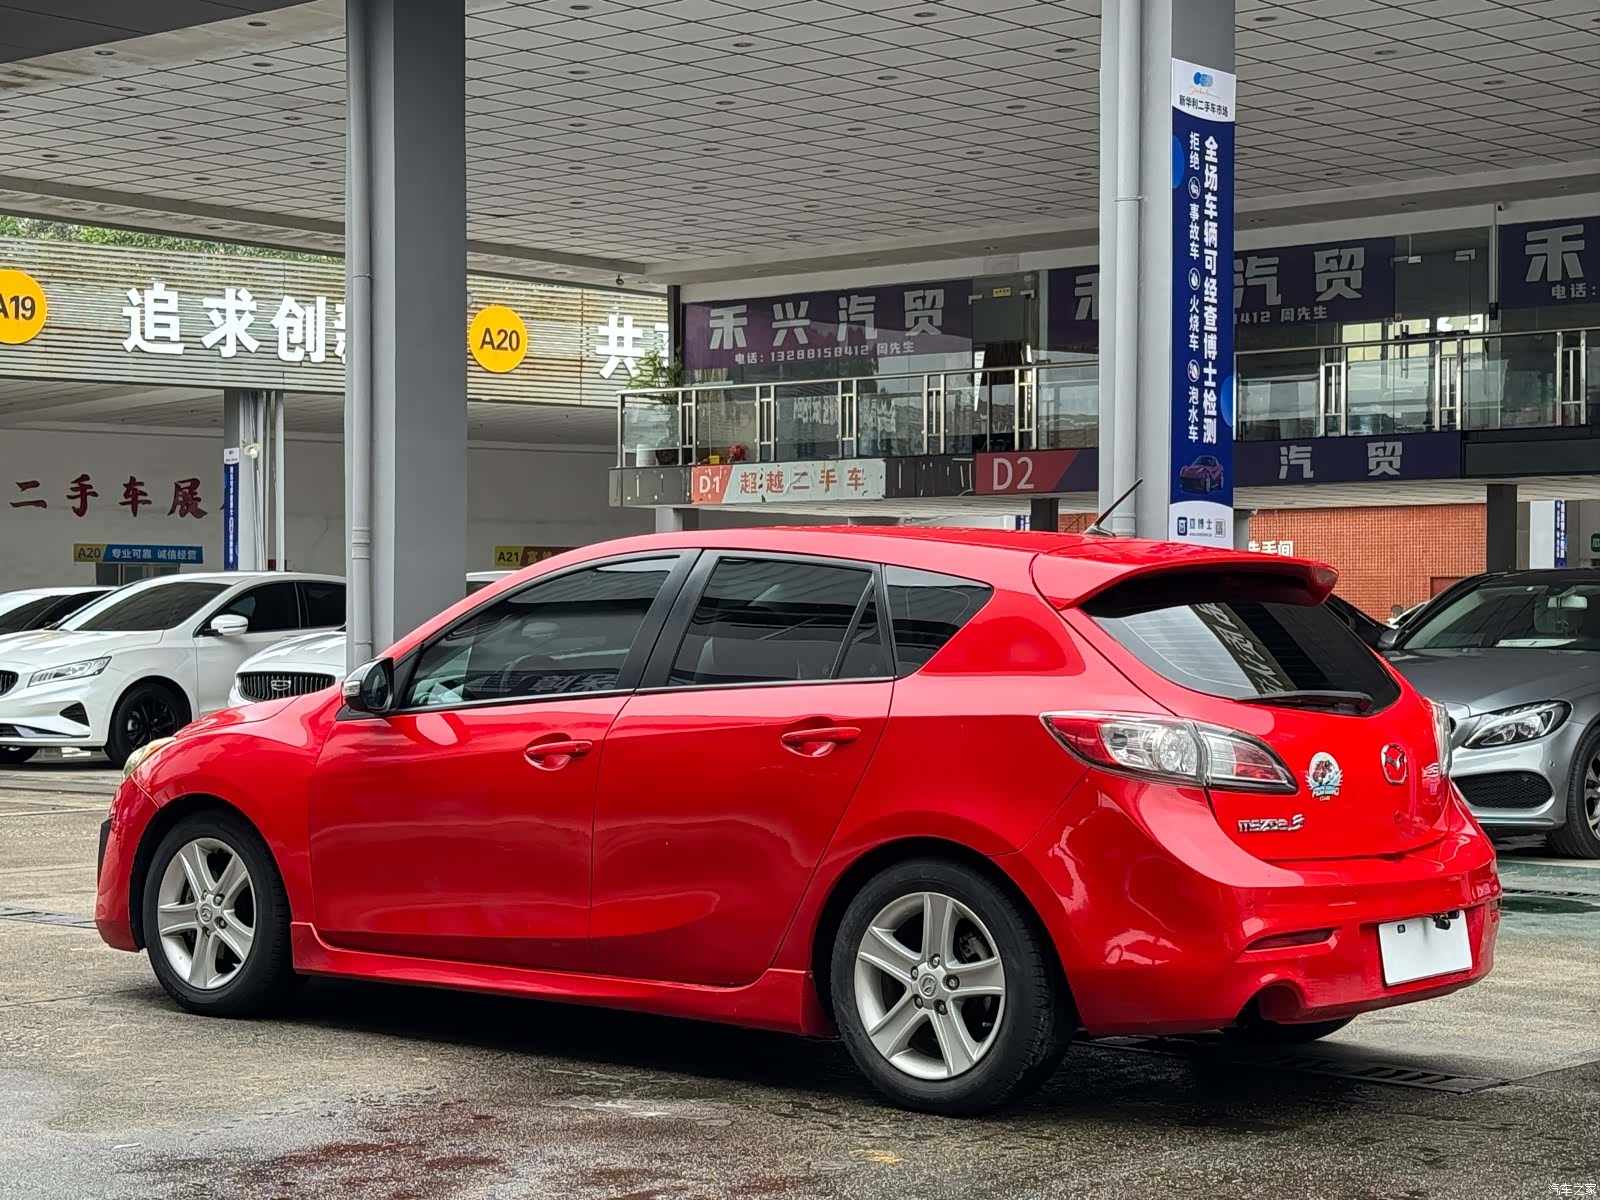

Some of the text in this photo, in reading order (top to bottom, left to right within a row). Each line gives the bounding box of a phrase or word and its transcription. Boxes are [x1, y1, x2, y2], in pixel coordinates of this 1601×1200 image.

[1179, 94, 1229, 117] 新华利二手车市场
[1189, 131, 1200, 170] 拒绝
[1189, 203, 1199, 260] 事故车
[1525, 224, 1585, 282] 禾
[1203, 136, 1218, 444] 全场车辆可经查博士检测
[122, 282, 346, 364] 追求创
[709, 289, 944, 349] 禾兴汽贸
[1189, 294, 1199, 351] 火烧车
[1280, 305, 1328, 323] 周先生
[479, 327, 520, 352] A20
[1188, 386, 1199, 443] 泡水车
[699, 474, 721, 494] D1
[740, 467, 866, 495] 超越二手车
[992, 456, 1035, 491] D2
[10, 474, 224, 519] 二手车展
[78, 548, 197, 560] A20 专业可靠 诚信经营
[498, 552, 519, 562] A21
